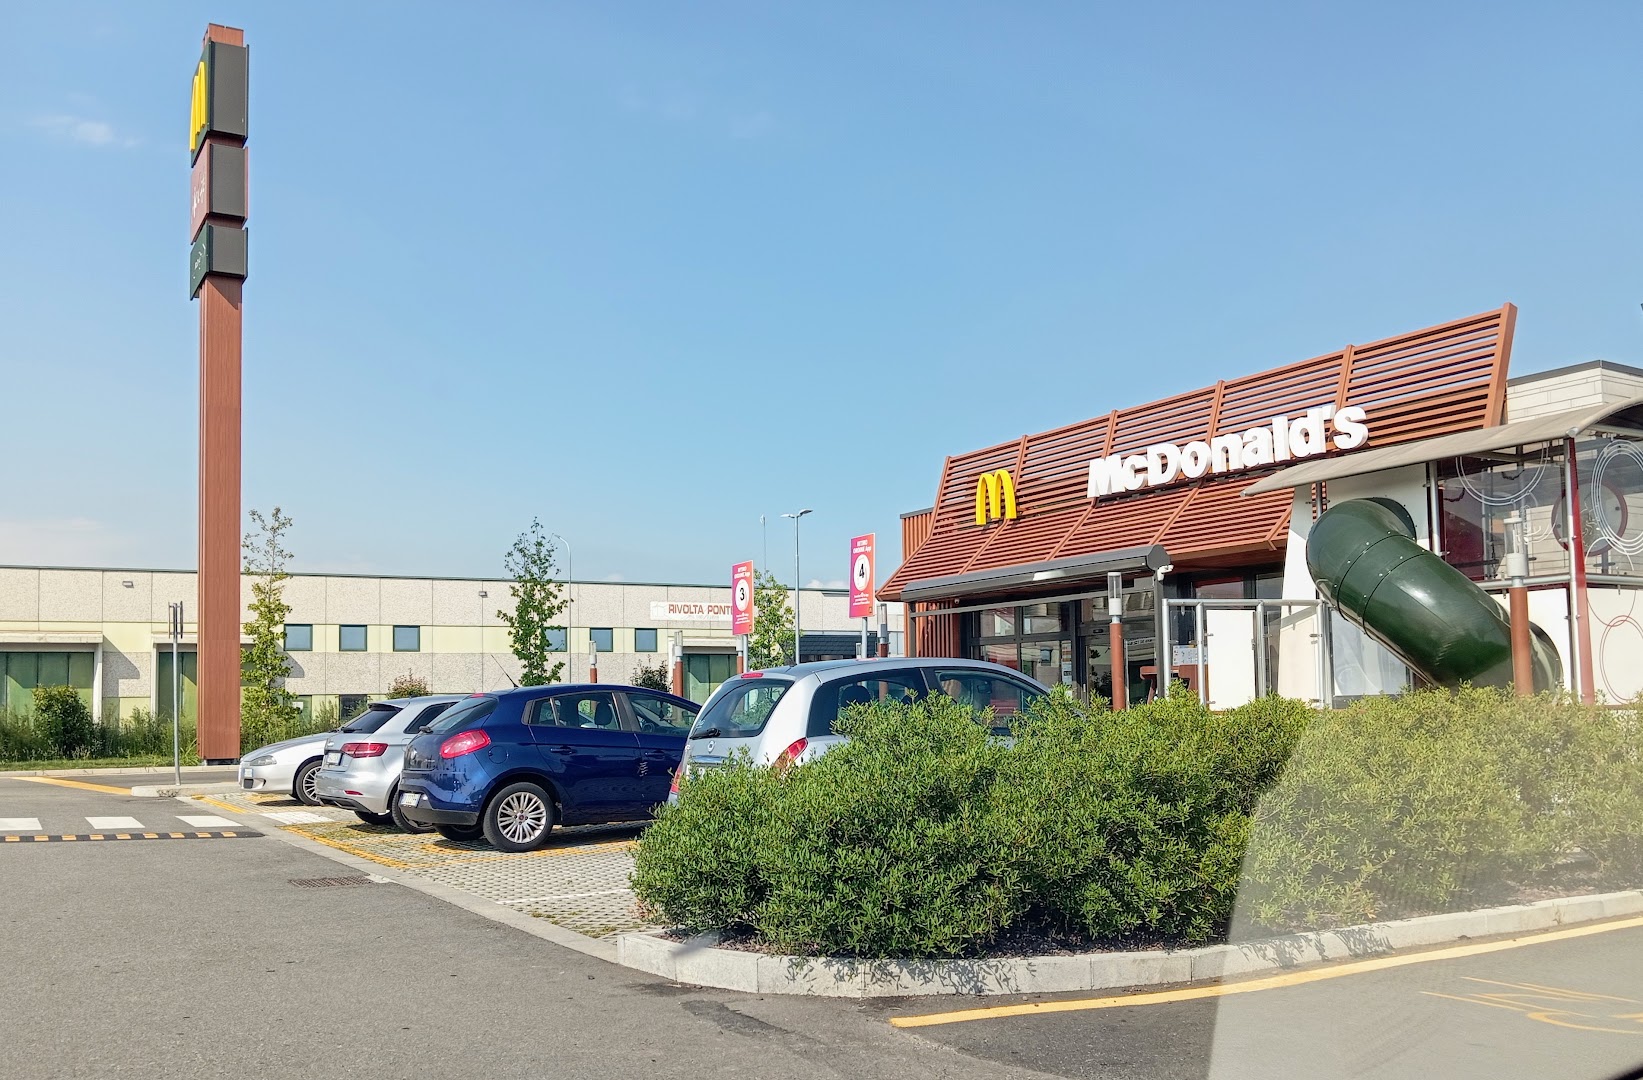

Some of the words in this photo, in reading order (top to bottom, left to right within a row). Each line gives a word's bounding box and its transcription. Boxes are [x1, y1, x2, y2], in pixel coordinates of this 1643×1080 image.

[1087, 405, 1369, 498] McDonald's
[859, 563, 865, 578] 4
[739, 587, 745, 601] 3
[668, 603, 704, 615] RIVOLTA
[707, 604, 732, 615] PONT
